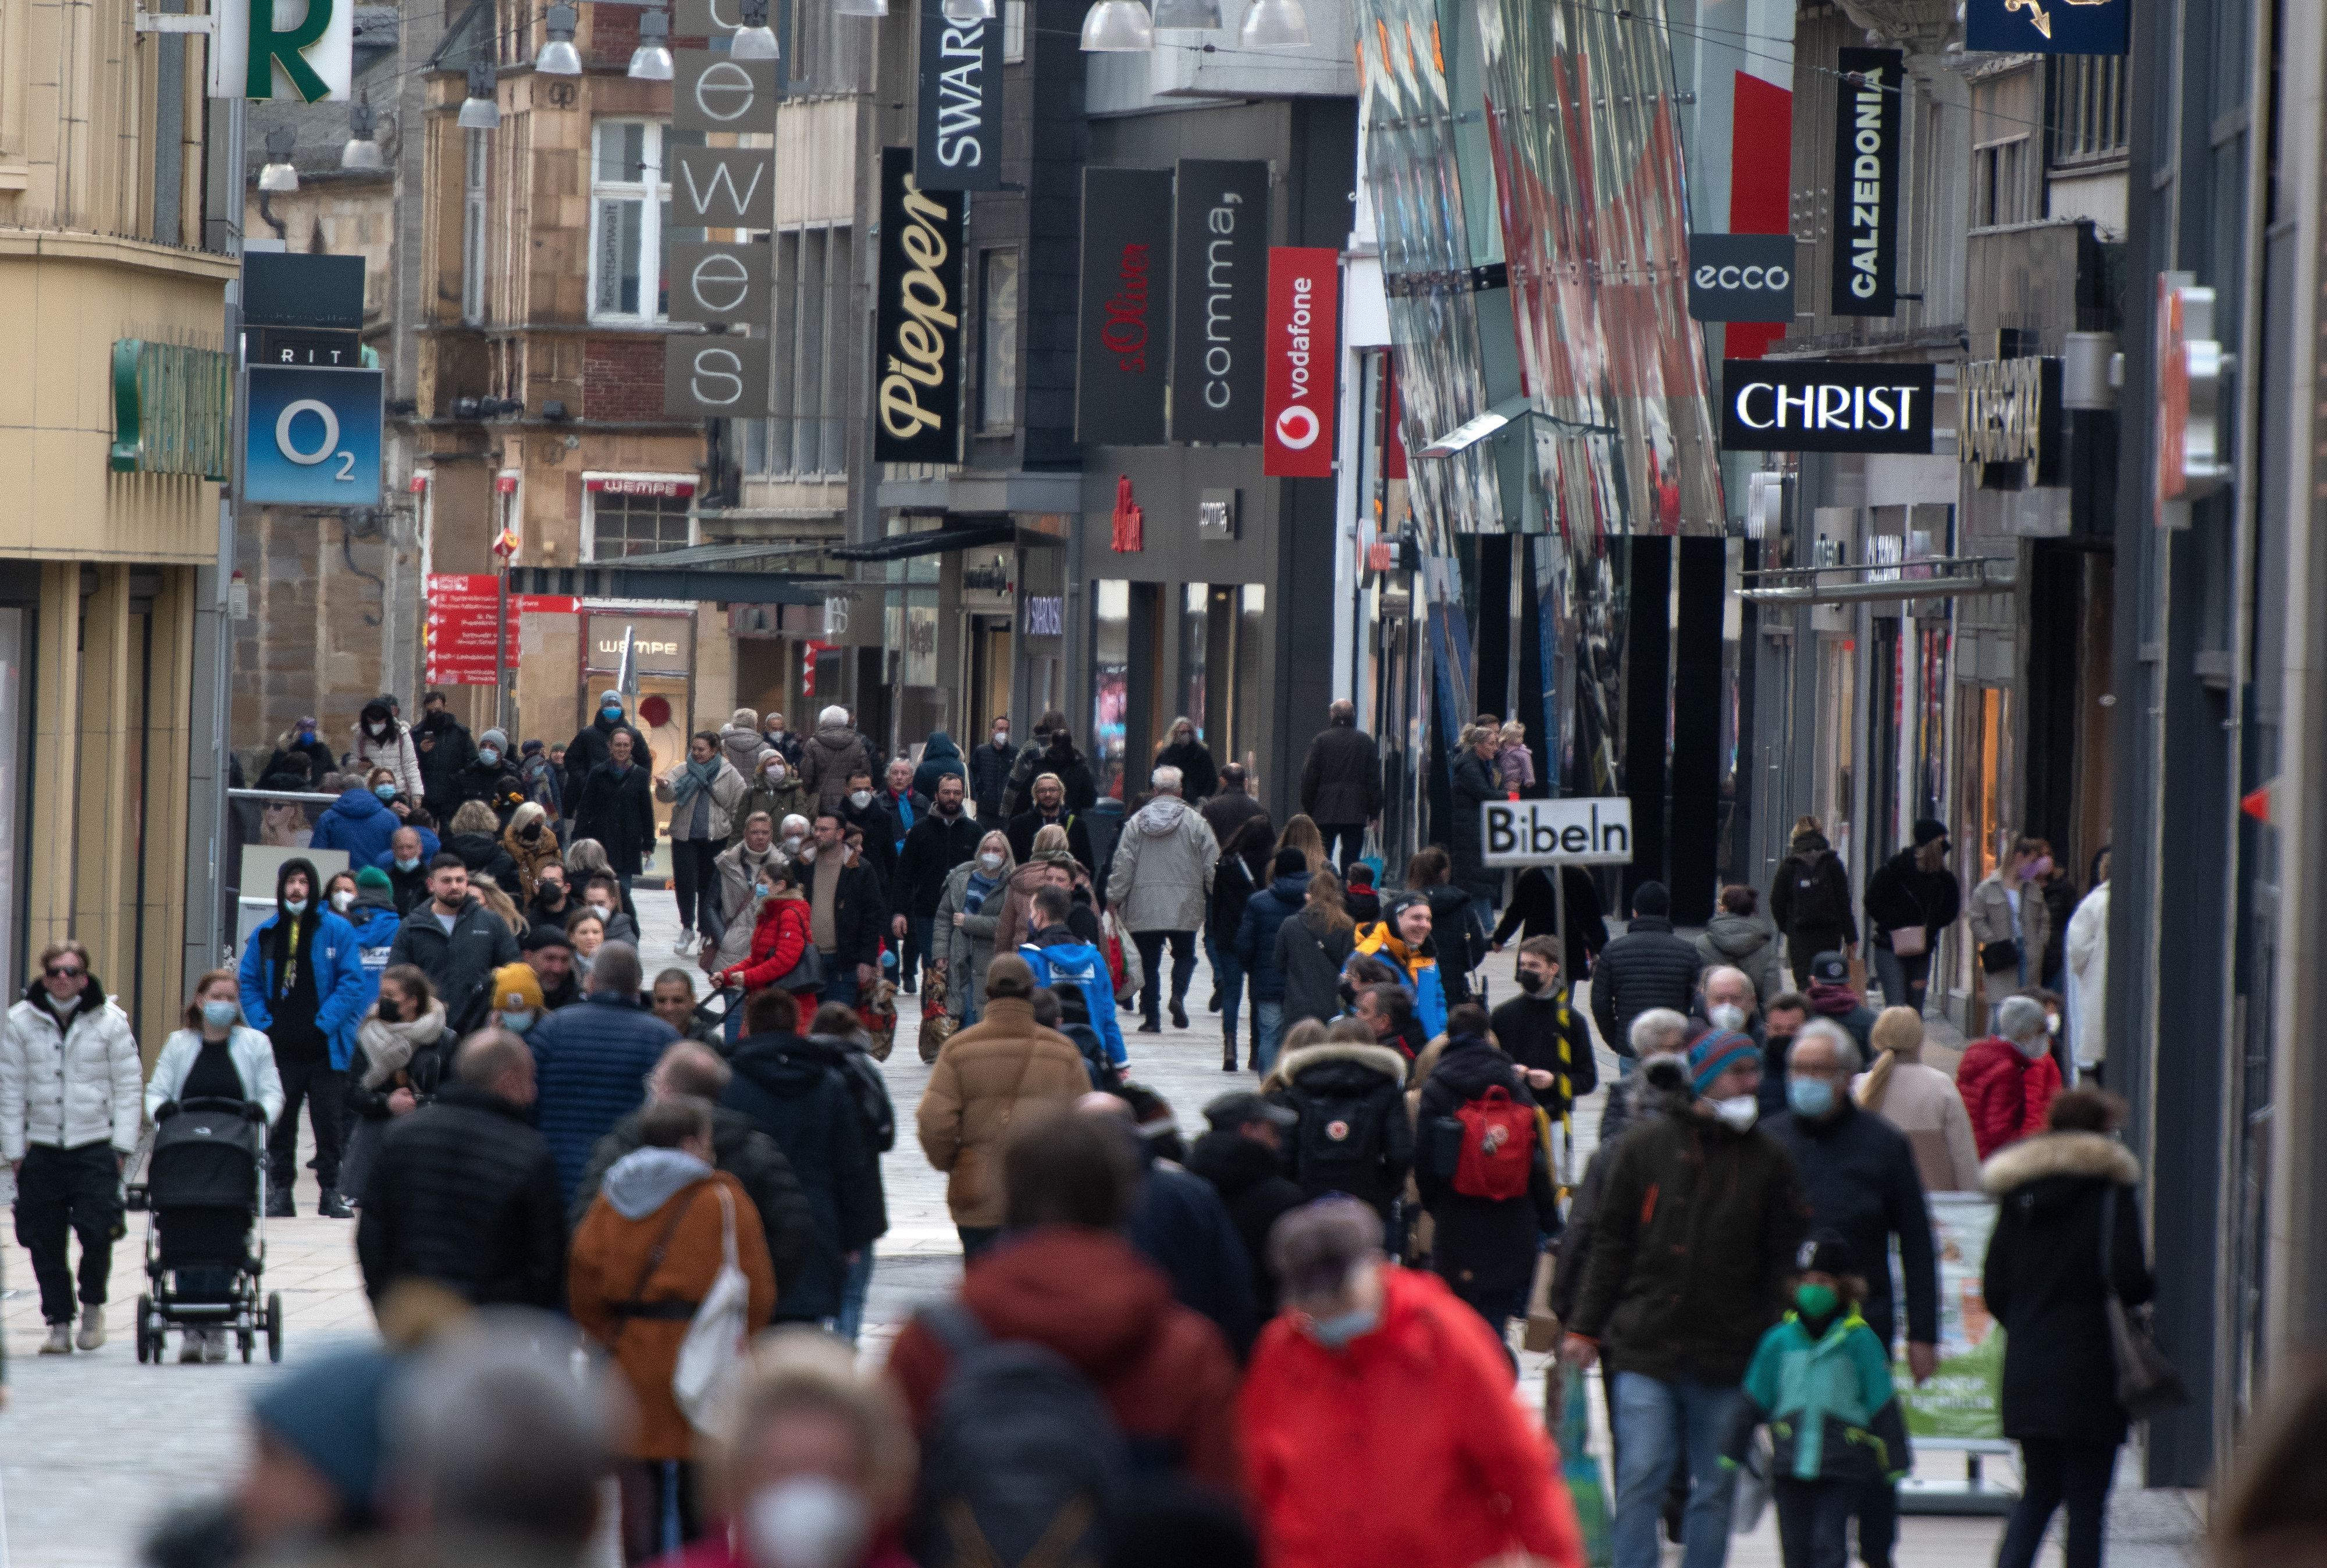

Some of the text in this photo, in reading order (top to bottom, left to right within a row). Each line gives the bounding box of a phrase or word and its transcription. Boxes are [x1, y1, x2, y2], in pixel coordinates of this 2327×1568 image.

[1851, 66, 1883, 299] CALZEDONIA
[1694, 265, 1790, 290] ecco
[880, 173, 957, 439] Pieper
[1101, 243, 1150, 373] s.Oliver
[1287, 277, 1312, 399] vodafone
[1735, 382, 1919, 429] CHRIST
[604, 480, 678, 496] WEMPE
[600, 640, 678, 655] WEMPE
[1487, 804, 1627, 853] Bibeln
